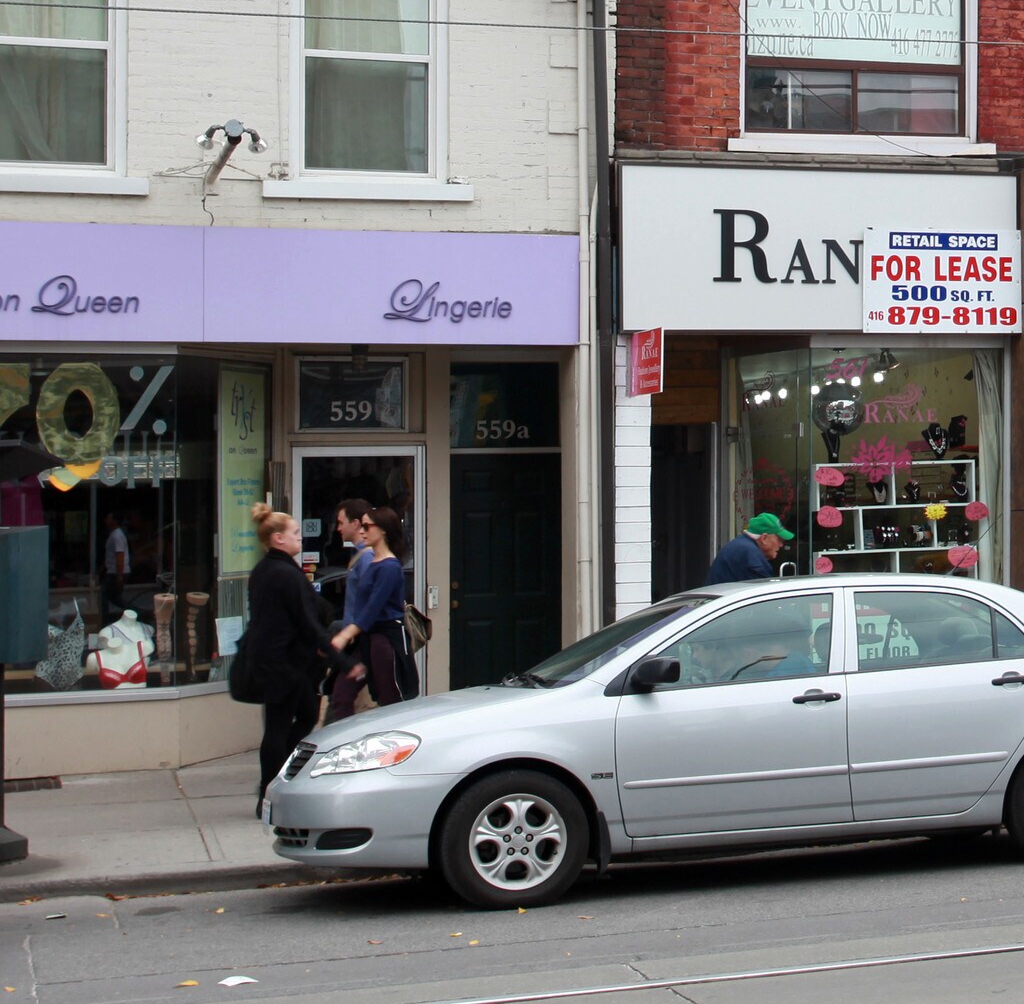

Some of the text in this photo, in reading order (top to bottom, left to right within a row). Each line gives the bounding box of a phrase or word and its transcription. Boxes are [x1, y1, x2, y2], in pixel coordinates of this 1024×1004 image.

[813, 11, 848, 39] BOOK
[857, 13, 892, 39] NOW
[746, 28, 814, 56] izune.ca
[892, 234, 996, 249] RETAIL SPACE
[871, 255, 1013, 282] FOR LEASE
[0, 275, 140, 316] n Queen
[384, 279, 513, 323] Lingerie
[892, 285, 995, 302] 500 SQ. FT.
[868, 306, 1017, 326] 416 879-8119
[329, 400, 373, 422] 559
[864, 403, 939, 425] RANAE
[475, 419, 530, 440] 559a
